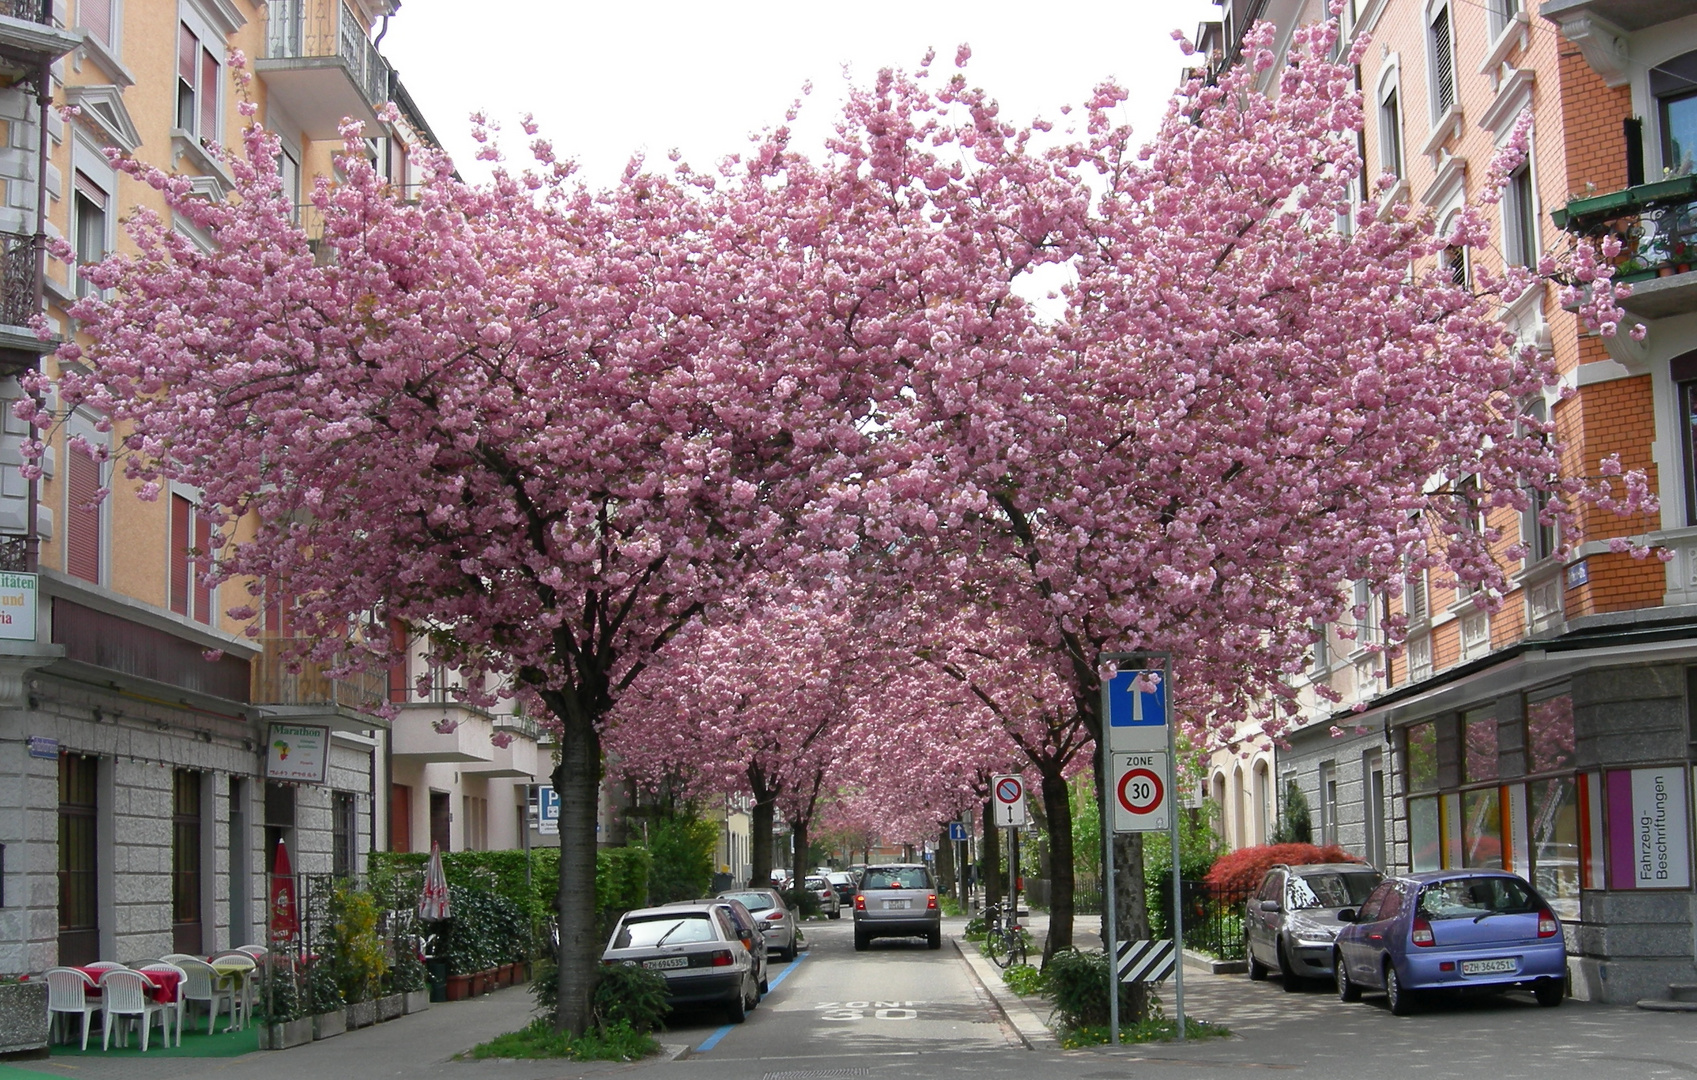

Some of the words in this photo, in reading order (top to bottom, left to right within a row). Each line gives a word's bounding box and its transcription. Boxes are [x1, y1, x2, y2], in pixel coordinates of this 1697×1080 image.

[2, 593, 25, 606] und
[273, 725, 321, 737] Marathon
[1126, 756, 1153, 766] ZONE
[548, 790, 559, 806] P
[1132, 783, 1150, 799] 30
[1655, 776, 1668, 879] Beschriftungen
[1640, 810, 1652, 880] Fahrzeug-
[821, 1008, 917, 1020] 30
